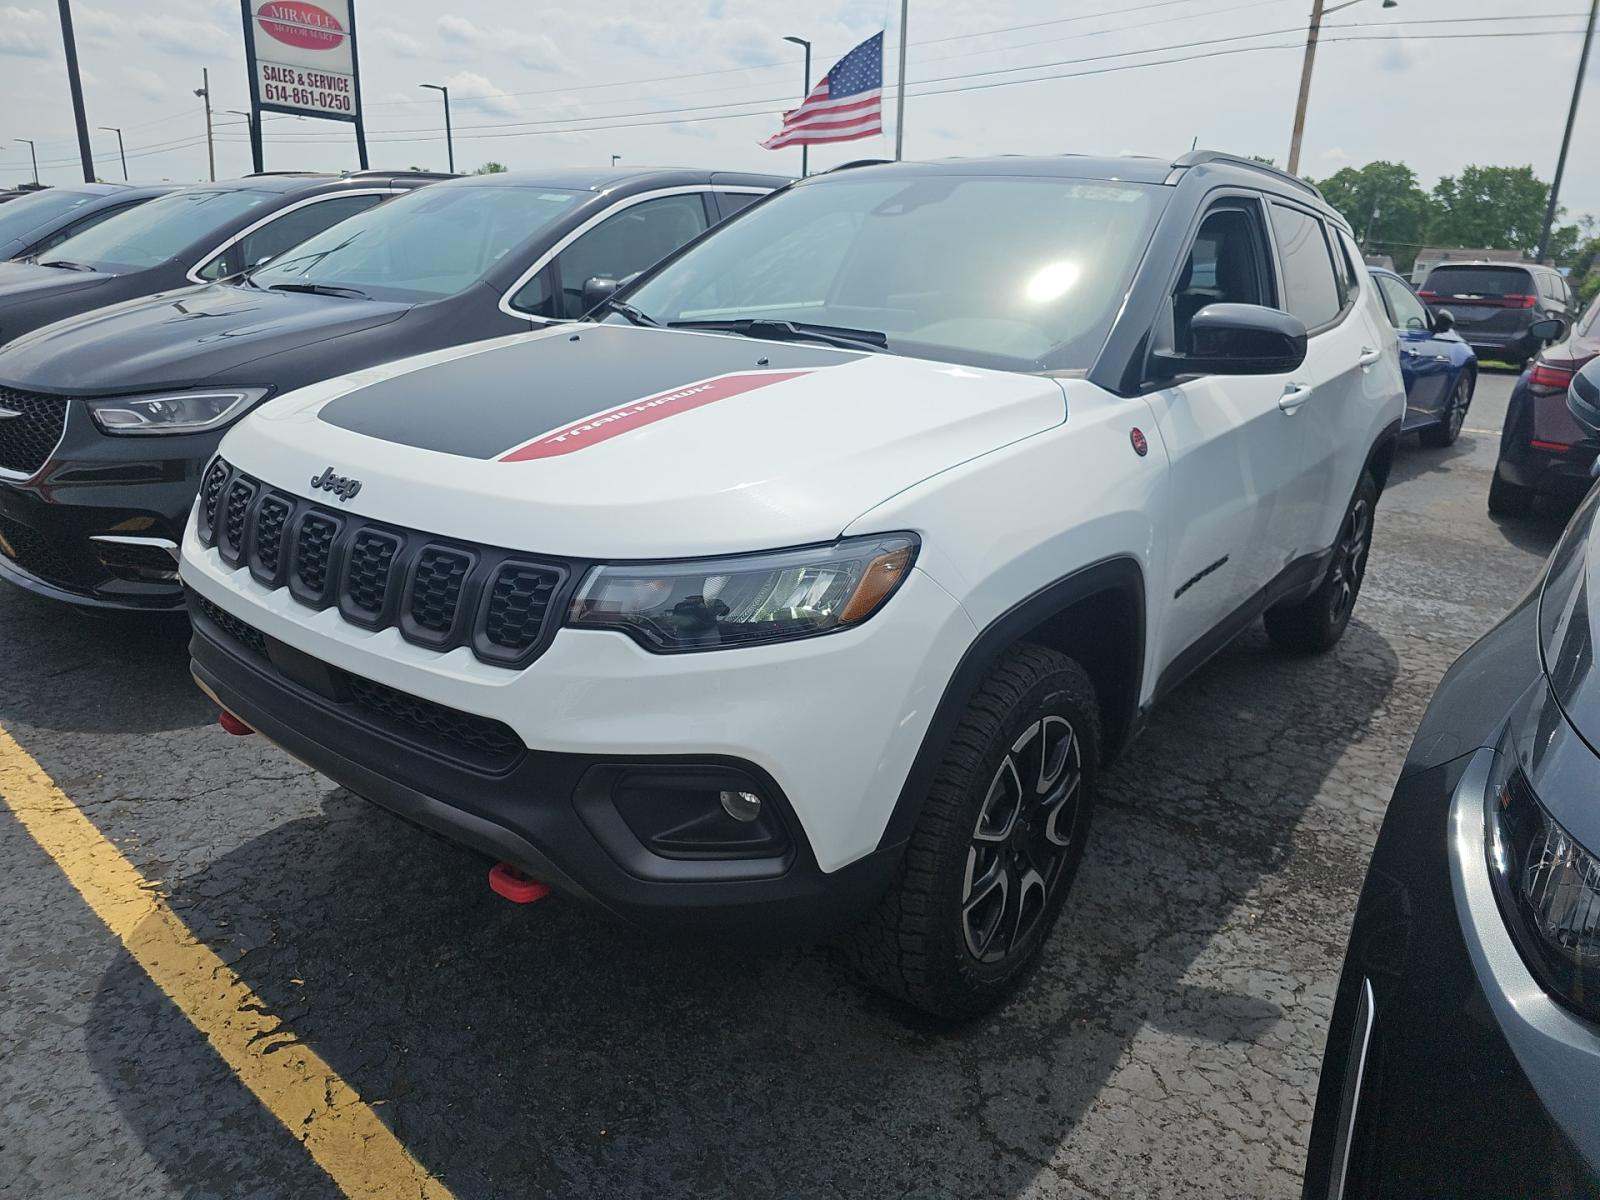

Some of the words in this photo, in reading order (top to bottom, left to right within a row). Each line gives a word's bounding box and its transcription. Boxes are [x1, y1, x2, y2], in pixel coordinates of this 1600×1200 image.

[271, 5, 336, 29] MIRACLE
[263, 65, 295, 85] SALES
[297, 73, 305, 87] &
[307, 72, 350, 93] SERVICE
[265, 83, 351, 111] 614-861-0250
[545, 383, 715, 444] TRAILHAWK
[310, 466, 362, 503] Jeep
